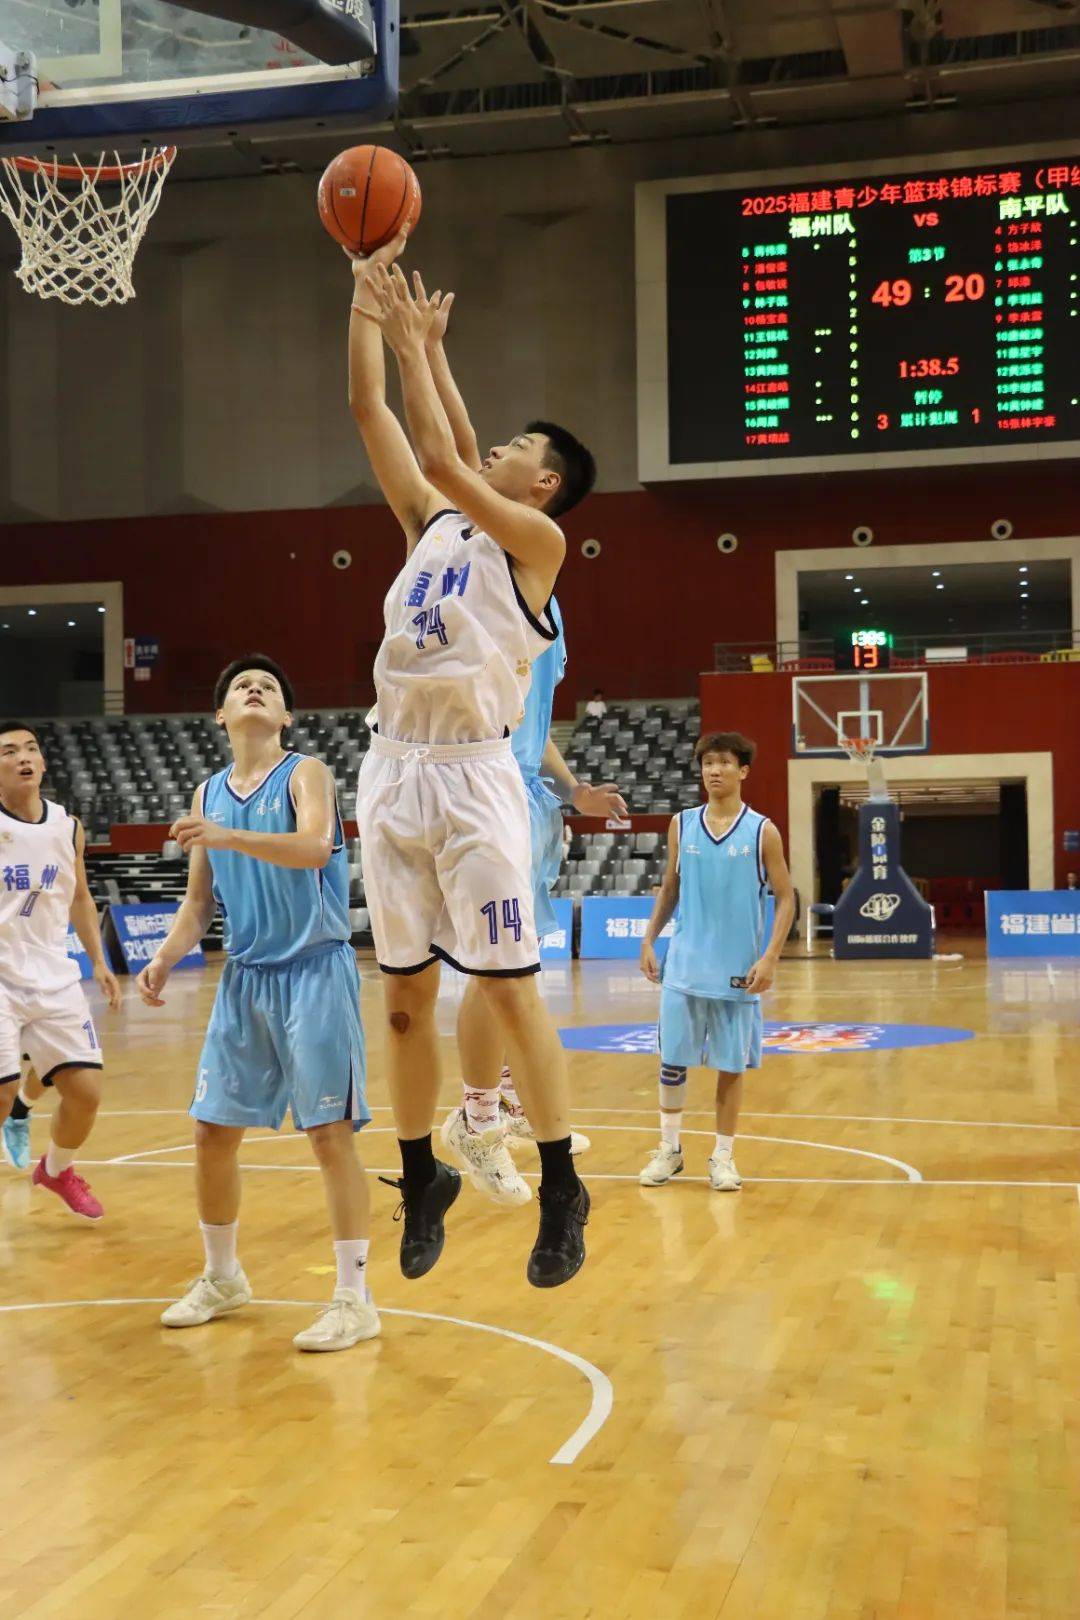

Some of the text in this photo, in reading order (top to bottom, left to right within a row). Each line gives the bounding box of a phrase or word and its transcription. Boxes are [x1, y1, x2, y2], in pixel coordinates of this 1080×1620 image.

[999, 192, 1069, 220] 南平队
[789, 213, 855, 238] 福州队
[872, 280, 912, 307] 49
[945, 273, 985, 303] 20
[899, 357, 960, 378] 1:38.5
[877, 414, 889, 430] 3
[971, 408, 980, 424] 1
[412, 604, 448, 649] 14
[855, 645, 877, 668] 13
[3, 865, 58, 891] 福州
[480, 898, 521, 944] 14
[1000, 913, 1080, 934] 福建省
